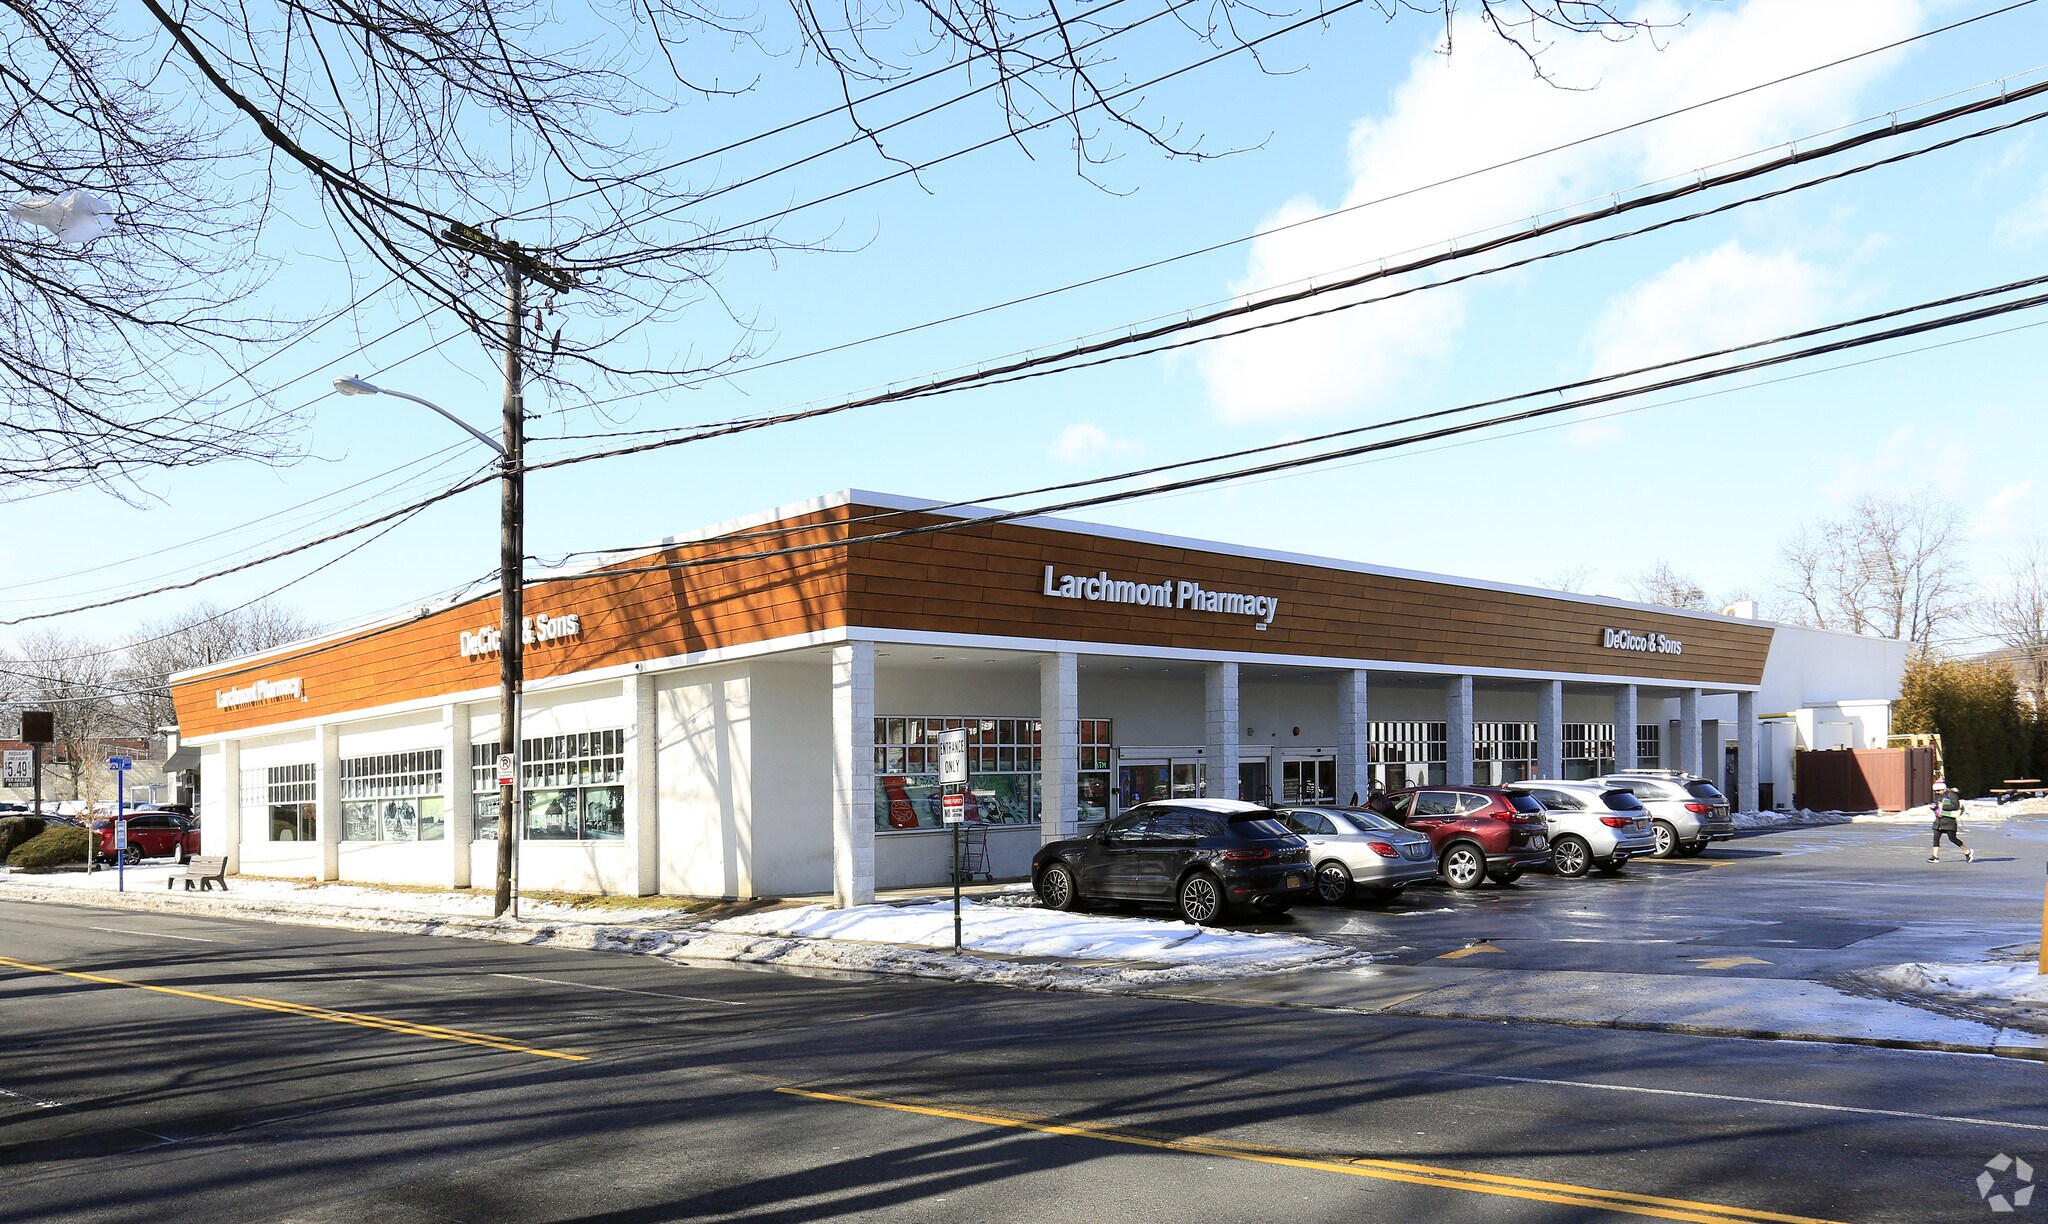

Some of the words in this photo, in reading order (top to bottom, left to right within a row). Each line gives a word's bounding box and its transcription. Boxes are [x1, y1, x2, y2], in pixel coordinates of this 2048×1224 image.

[1043, 565, 1172, 607] Larchmont
[1176, 580, 1278, 623] Pharmacy
[460, 625, 501, 657] DeCic
[522, 617, 536, 644] &
[536, 614, 579, 642] Sons
[1603, 628, 1647, 652] DeCicco
[1647, 633, 1656, 653] &
[1656, 634, 1682, 655] Sons
[940, 740, 964, 755] ENTRANCE
[944, 760, 960, 773] ONLY
